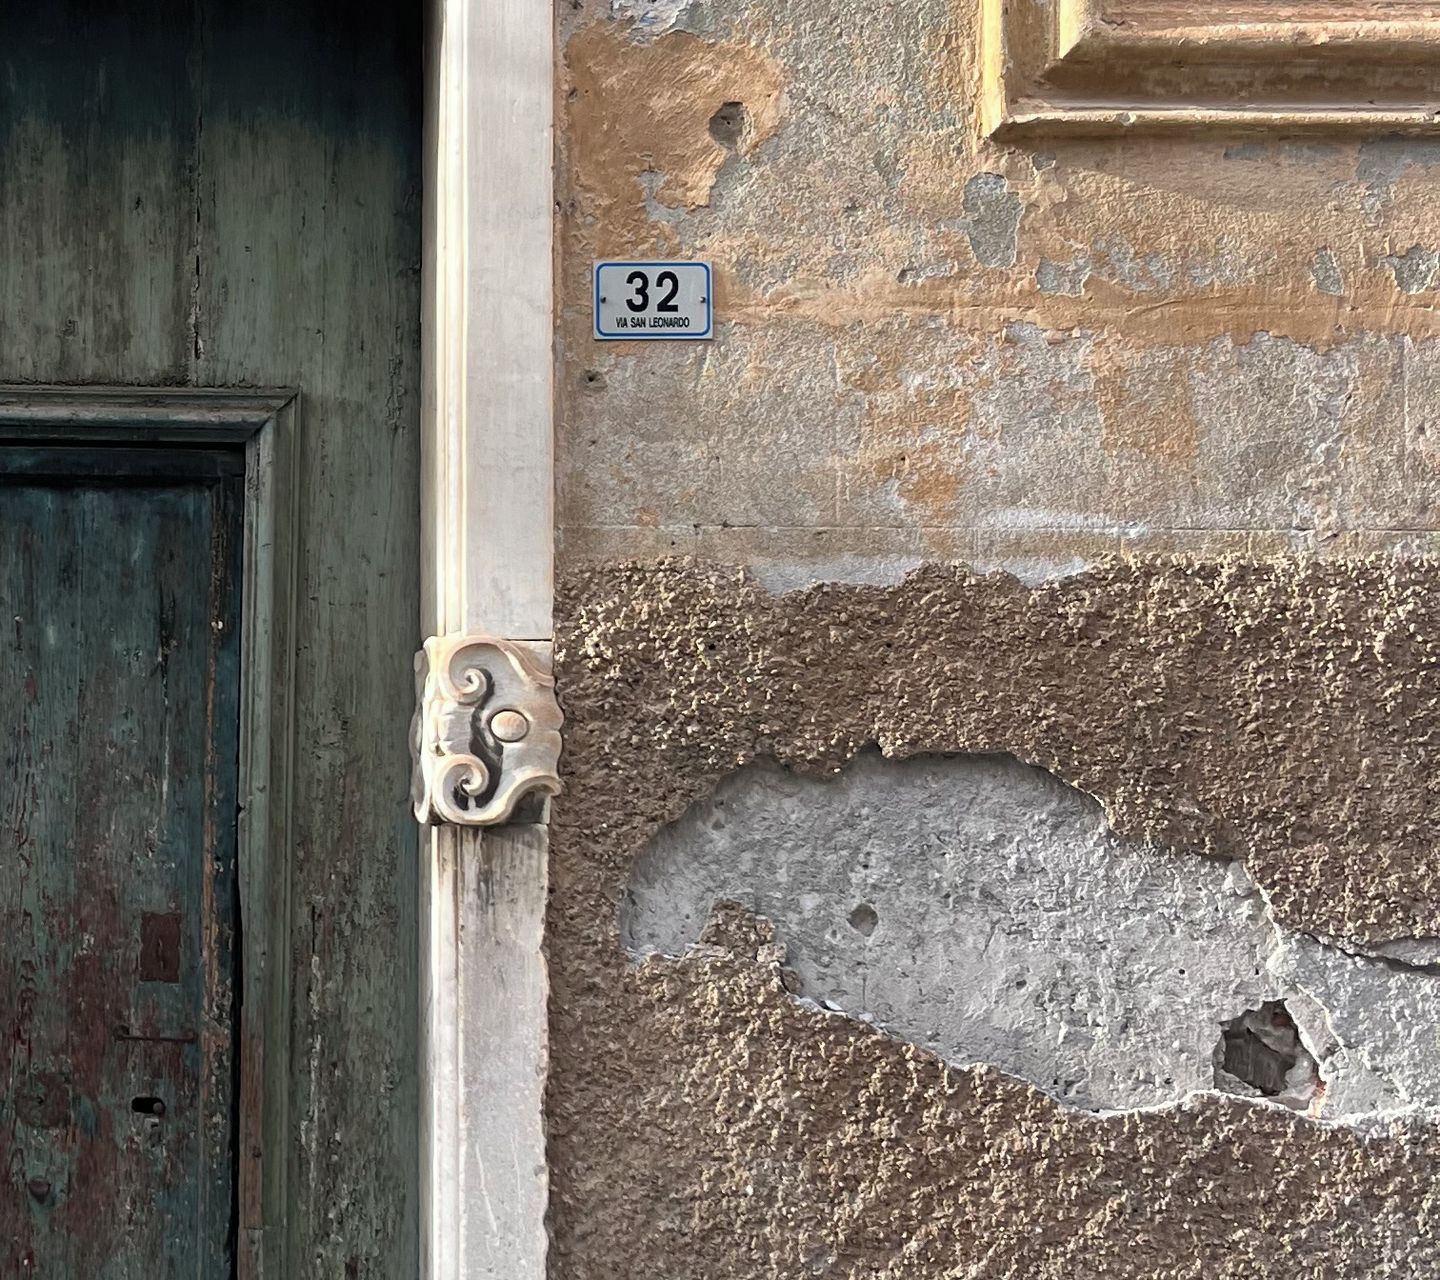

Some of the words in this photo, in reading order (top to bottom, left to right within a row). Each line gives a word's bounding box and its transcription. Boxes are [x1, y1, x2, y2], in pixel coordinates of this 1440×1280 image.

[625, 270, 679, 312] 32
[615, 316, 628, 328] VIA
[630, 316, 646, 328] SAN
[648, 316, 690, 328] LEONARDO
